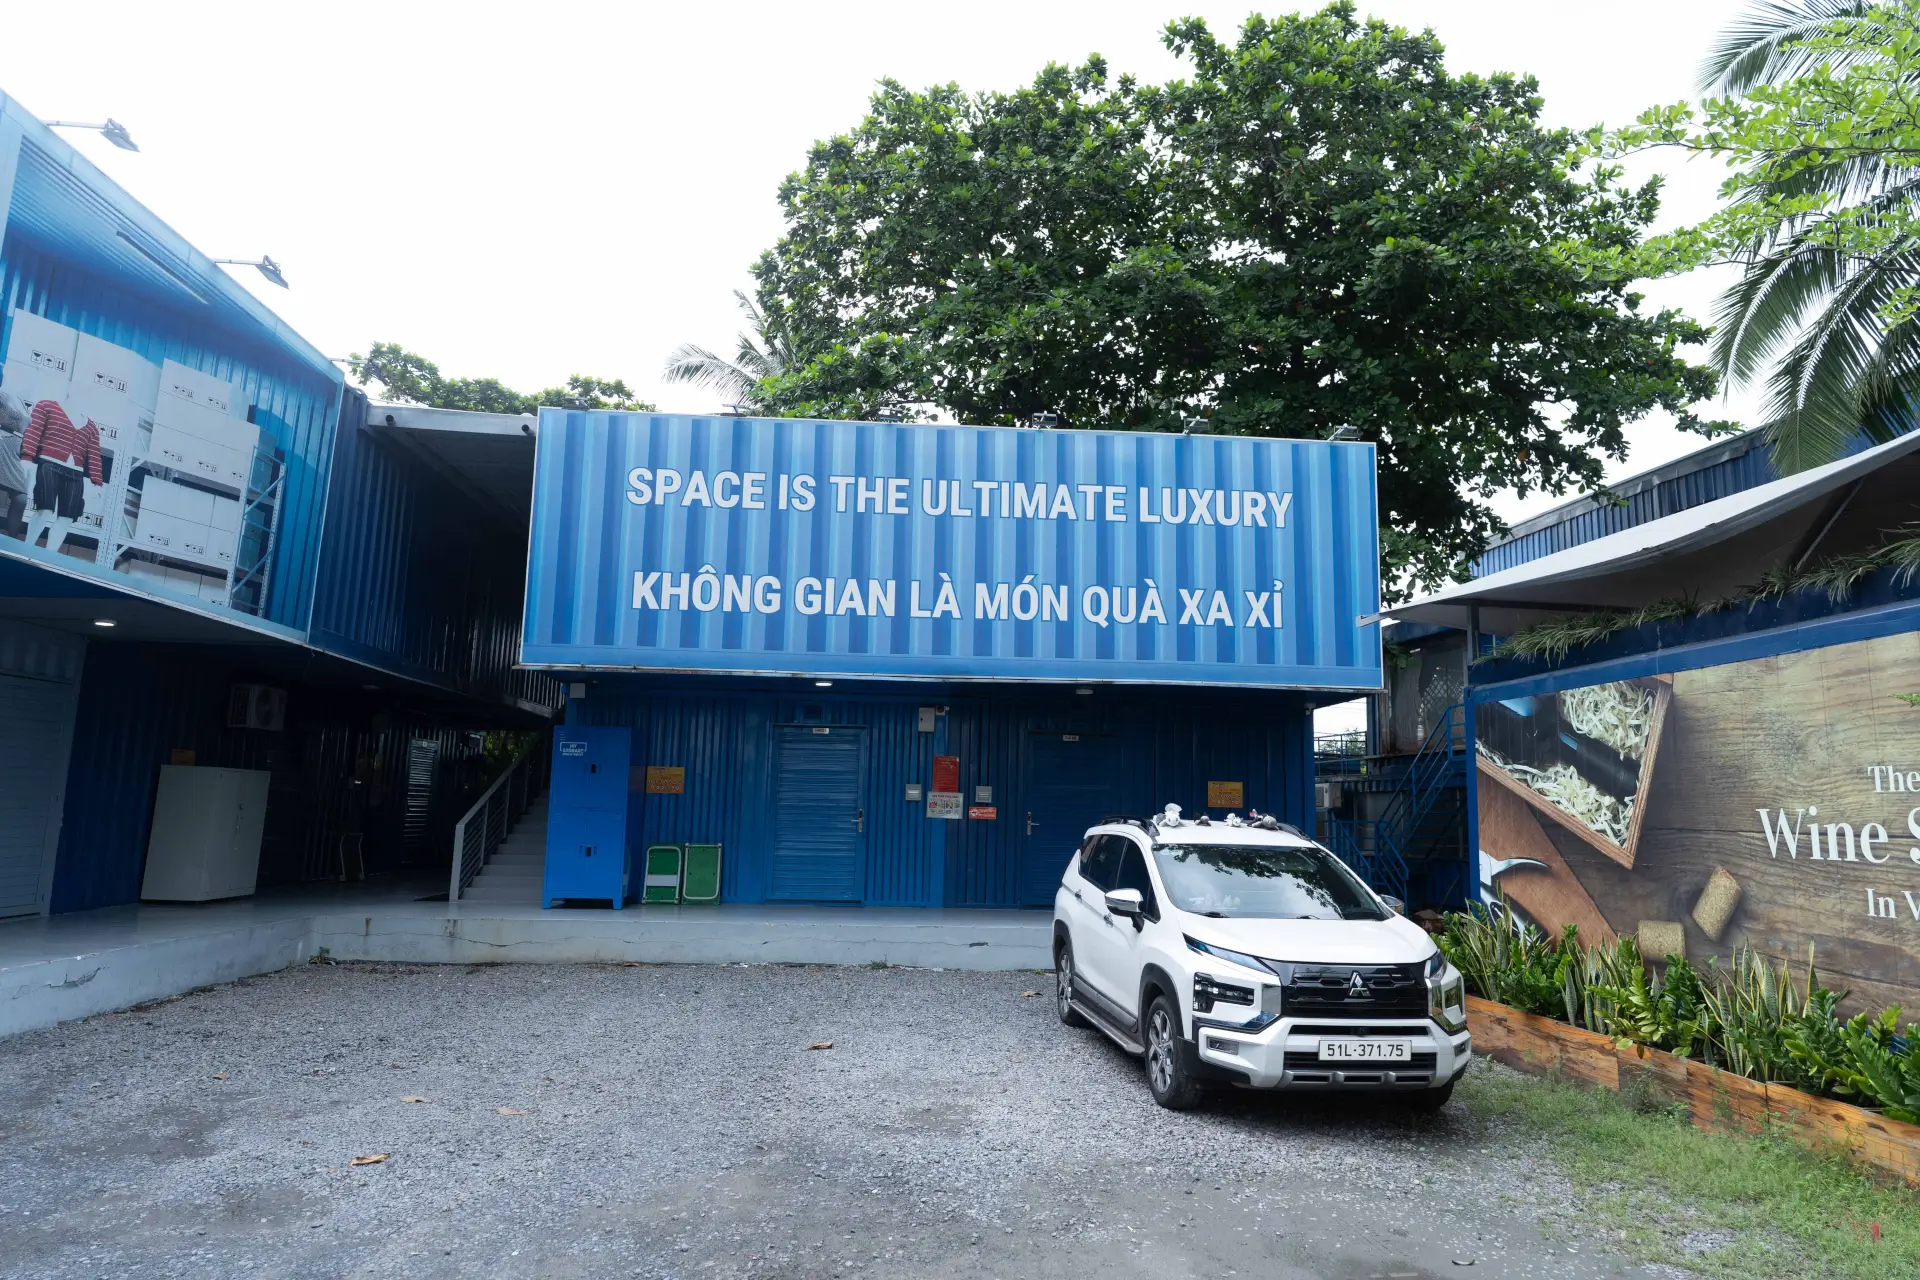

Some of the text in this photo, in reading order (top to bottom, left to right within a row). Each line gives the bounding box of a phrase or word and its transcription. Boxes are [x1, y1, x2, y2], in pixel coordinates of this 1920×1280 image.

[626, 467, 1293, 528] SPACE IS THE ULTIMATE LUXURY
[632, 564, 1284, 629] KHÔNG GIAN LÀ MÓN QUÀ XA XỈ
[1867, 765, 1920, 793] The
[1756, 805, 1890, 864] Wine
[1865, 888, 1897, 919] In
[1327, 1043, 1404, 1057] 51L-371.75
